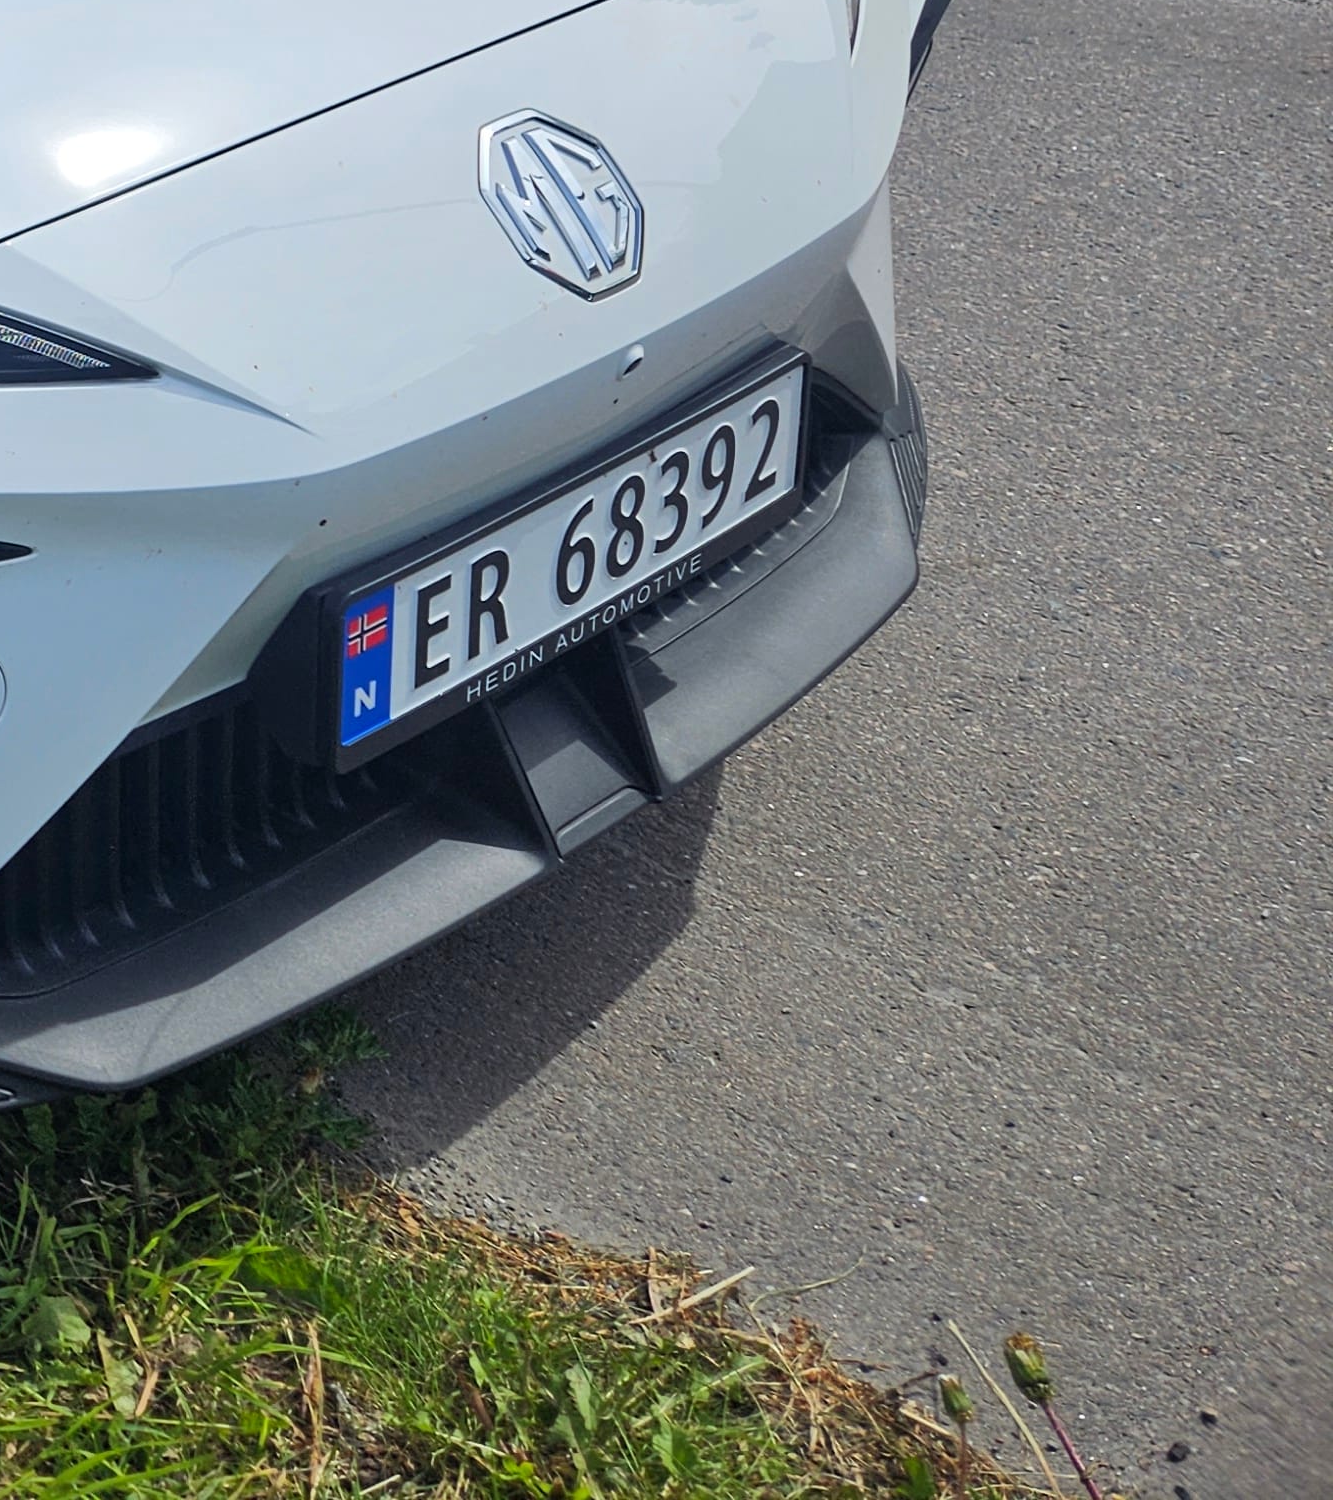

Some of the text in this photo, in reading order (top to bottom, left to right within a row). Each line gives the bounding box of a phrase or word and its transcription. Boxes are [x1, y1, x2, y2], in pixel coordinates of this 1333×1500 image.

[495, 127, 631, 283] MG
[413, 397, 781, 690] ER 68392
[353, 679, 377, 718] N
[466, 553, 702, 702] HEDIN AUTOMOTIVE
